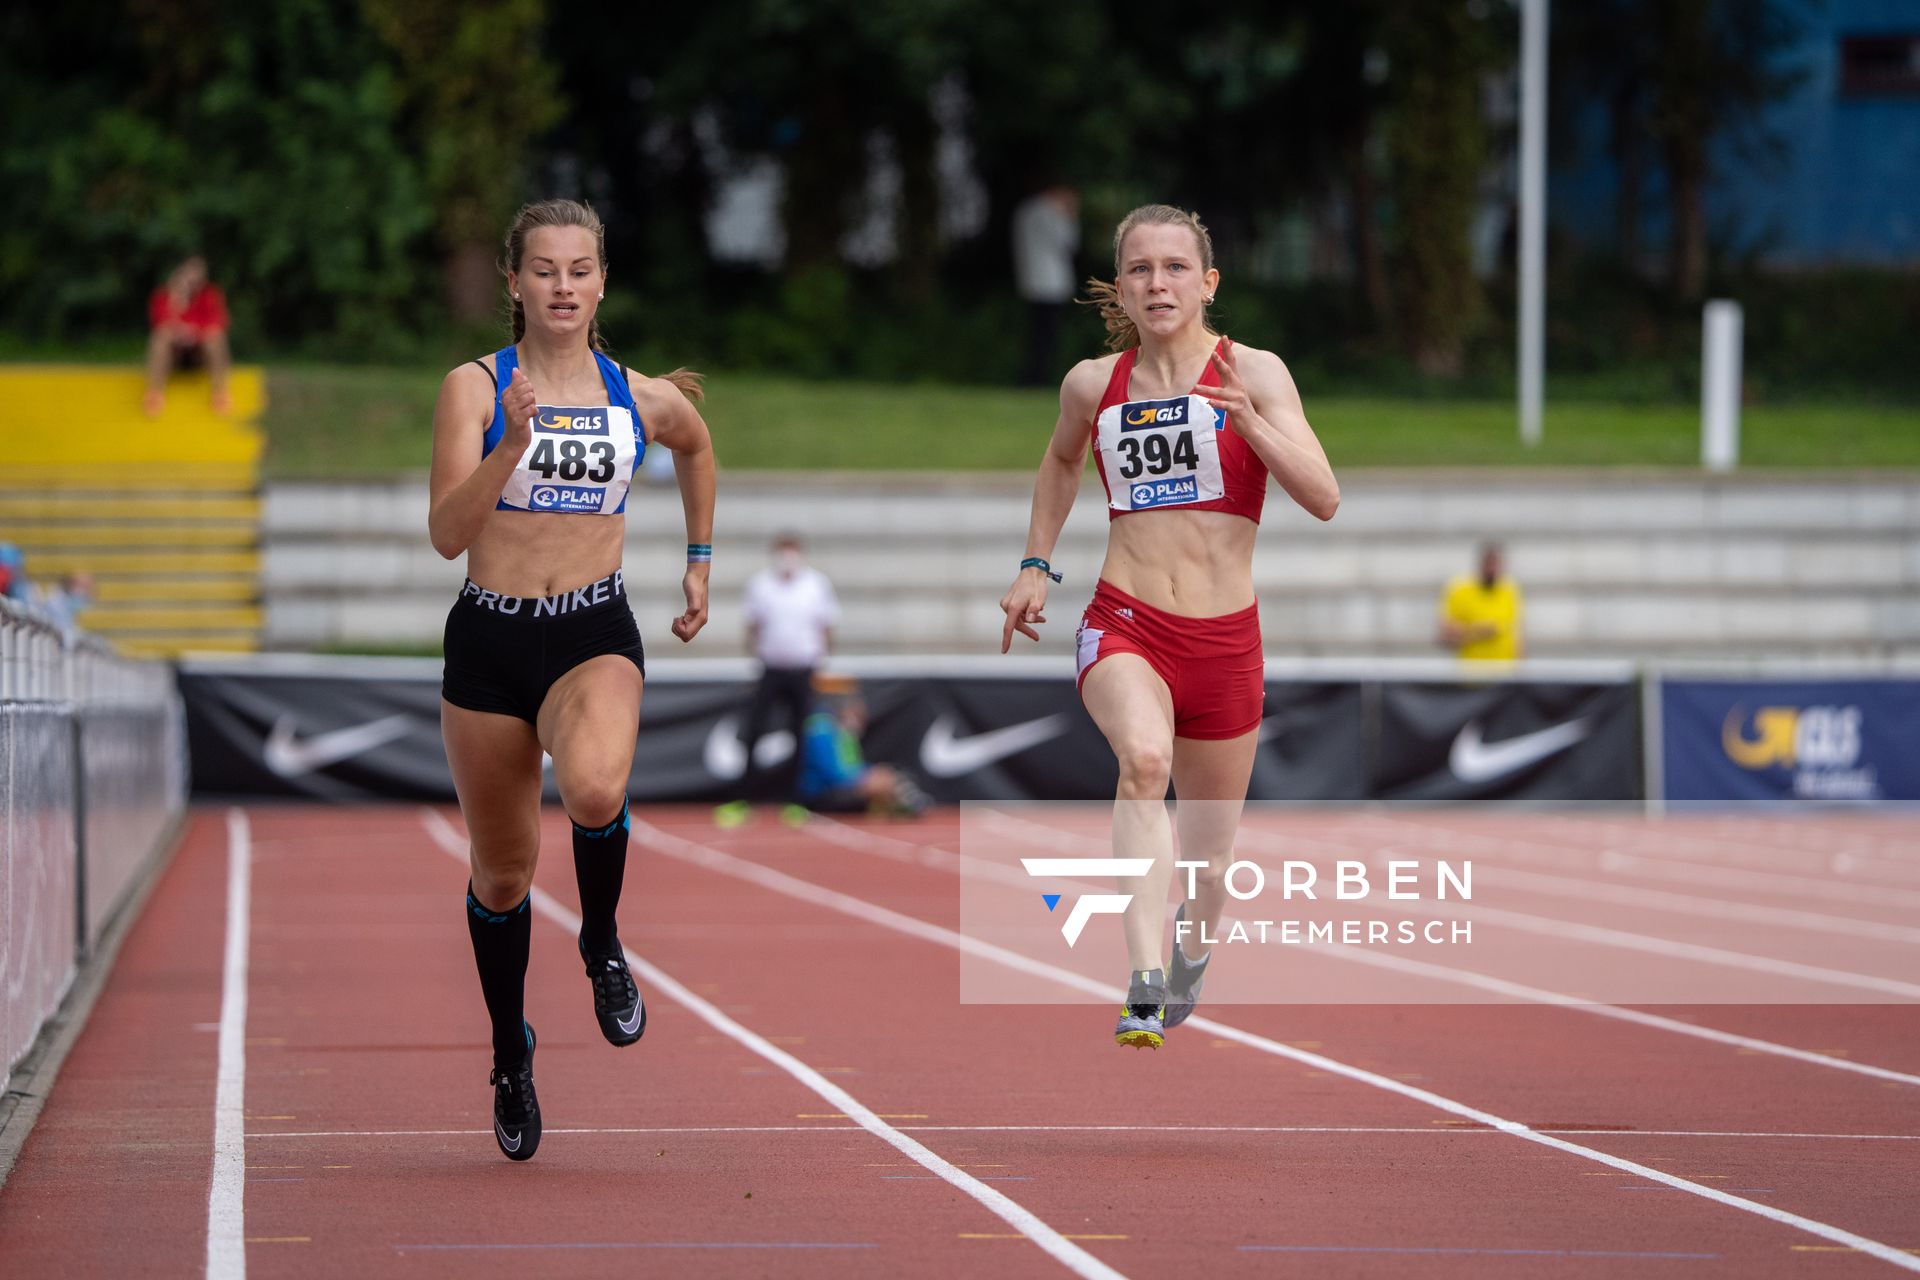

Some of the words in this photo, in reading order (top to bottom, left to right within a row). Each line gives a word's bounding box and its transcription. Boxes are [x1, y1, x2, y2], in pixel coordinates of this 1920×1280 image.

[1156, 405, 1183, 422] GLS
[572, 416, 602, 430] GLS
[528, 438, 616, 483] 483
[1117, 430, 1200, 479] 394
[1156, 480, 1195, 496] PLAN
[560, 490, 602, 504] PLAN
[1157, 493, 1196, 502] INTERNATIONAL
[560, 503, 599, 511] INTERNATIONAL
[463, 581, 522, 615] PRO
[533, 576, 610, 617] NIKE
